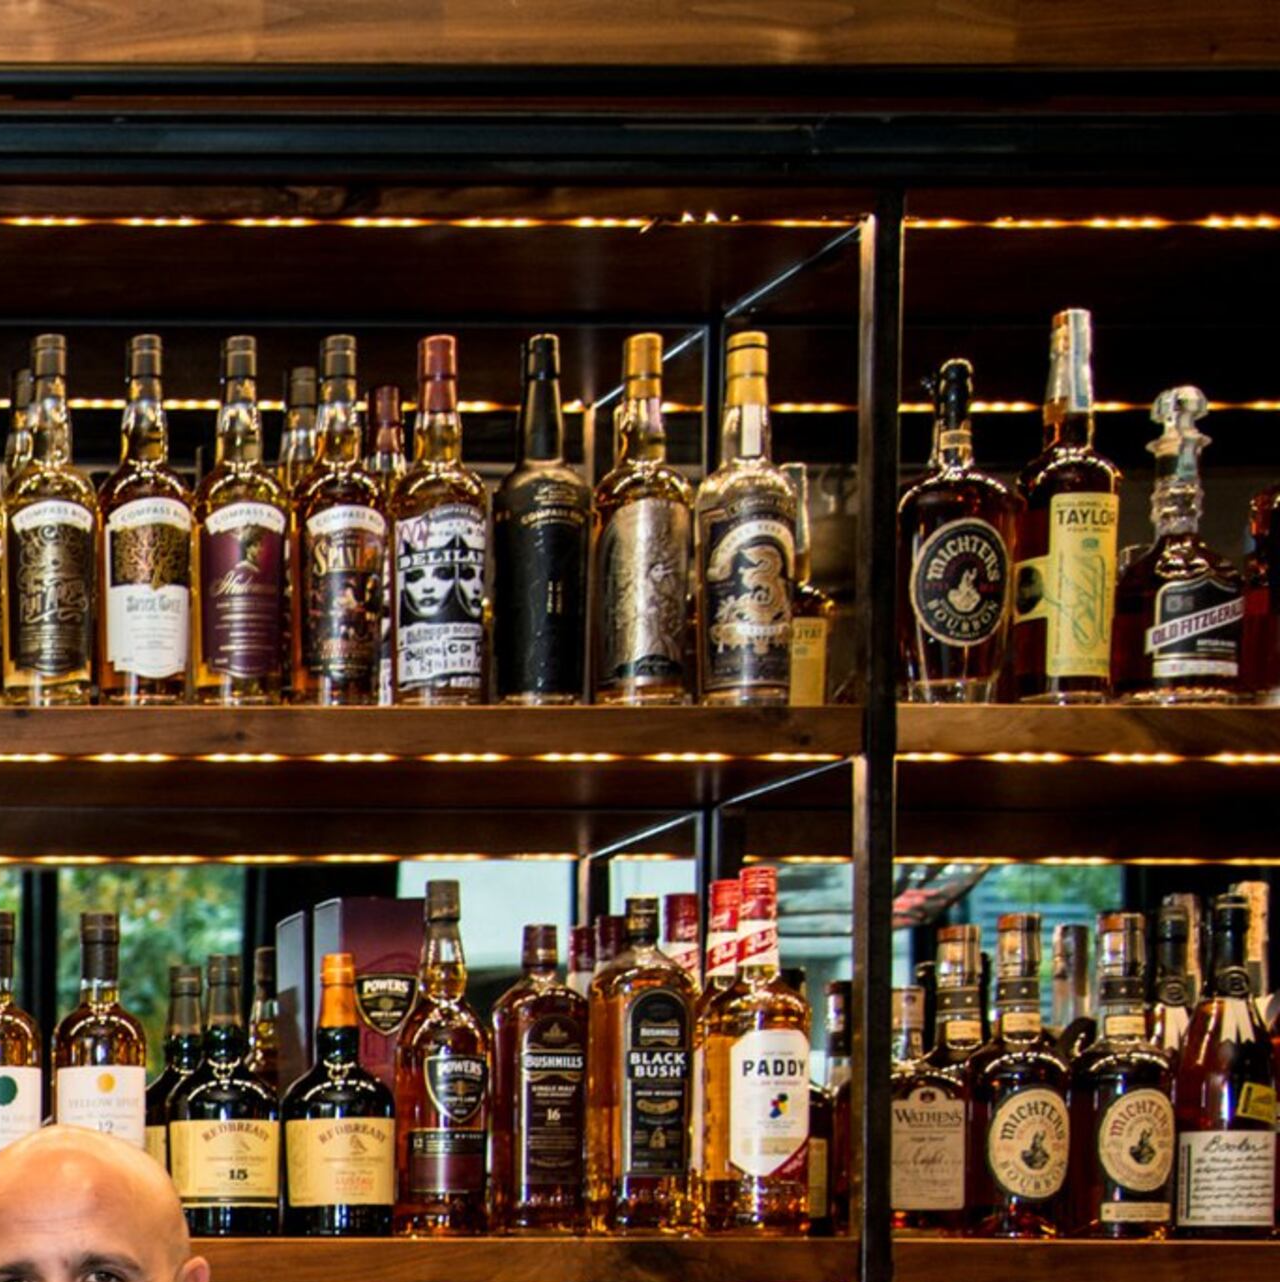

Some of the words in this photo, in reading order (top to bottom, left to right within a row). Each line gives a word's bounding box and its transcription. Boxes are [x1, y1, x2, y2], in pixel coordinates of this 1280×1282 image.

[121, 505, 170, 523] COMPASS
[927, 600, 999, 634] BOURBON
[1151, 622, 1178, 645] OLD
[363, 978, 410, 994] POWERS
[524, 1055, 583, 1069] BUSHMILLS
[630, 1052, 685, 1065] BLACK
[436, 1060, 482, 1076] POWERS
[635, 1065, 682, 1078] BUSH
[742, 1059, 806, 1077] PADDY
[546, 1108, 560, 1121] 16
[202, 1121, 270, 1143] REDBREAST
[318, 1122, 386, 1144] REDBREAST
[229, 1168, 248, 1181] 15
[999, 1159, 1066, 1193] BOURBON
